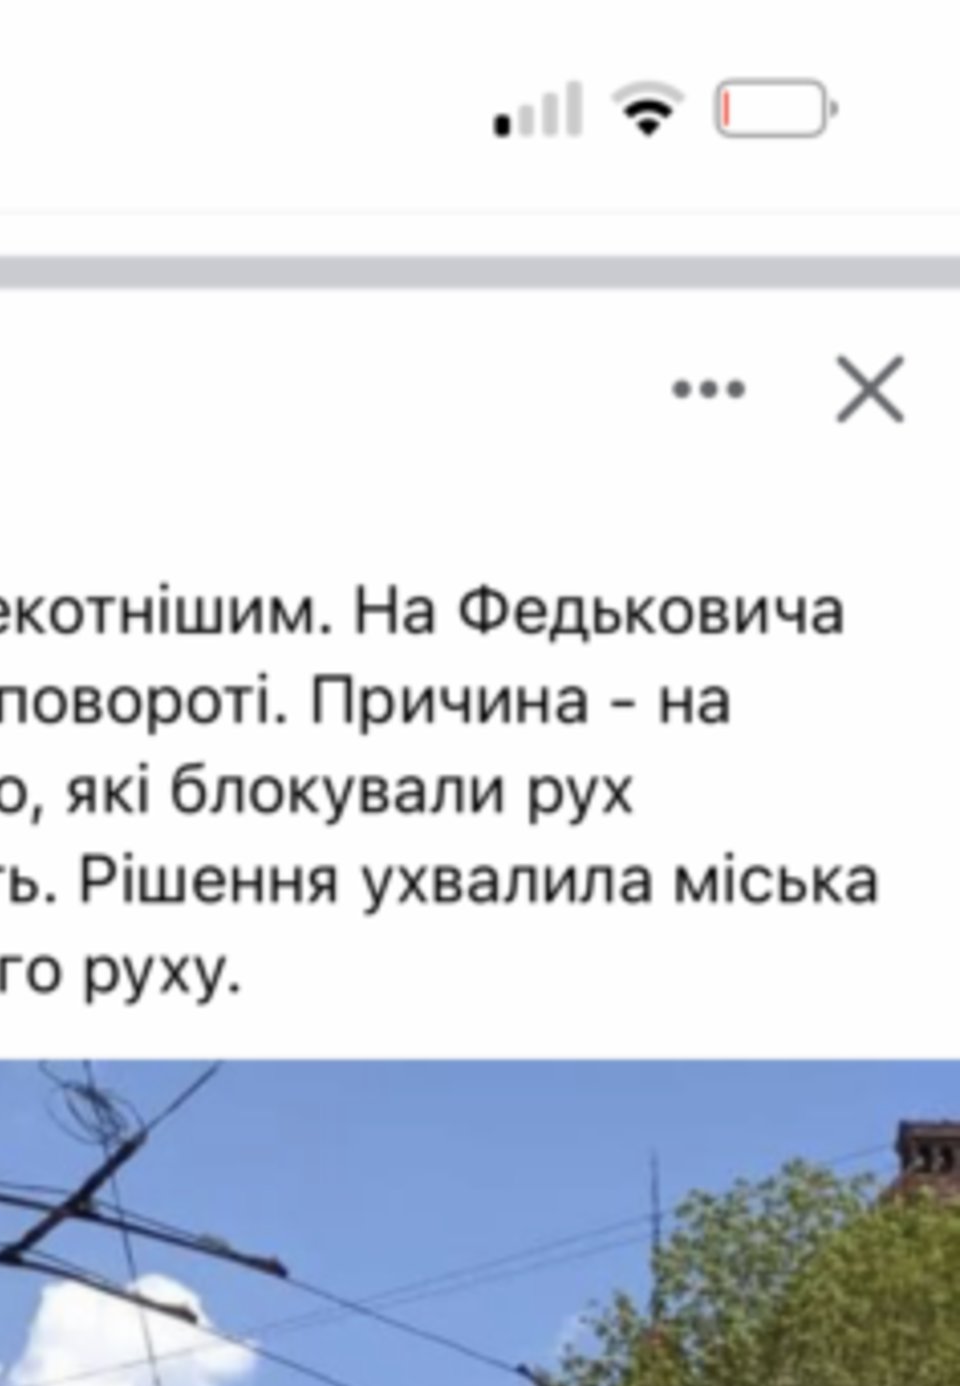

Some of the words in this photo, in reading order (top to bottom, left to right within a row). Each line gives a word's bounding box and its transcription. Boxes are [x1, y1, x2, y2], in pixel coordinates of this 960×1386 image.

[356, 584, 434, 635] На
[459, 584, 843, 643] Федьковича
[313, 673, 587, 736] Причина
[660, 685, 729, 724] на
[67, 762, 148, 814] які
[171, 762, 503, 826] блокували
[529, 775, 632, 826] рух
[81, 852, 336, 904] Рішення
[362, 865, 652, 916] ухвалила
[675, 852, 877, 905] міська
[85, 954, 239, 1006] руху.
